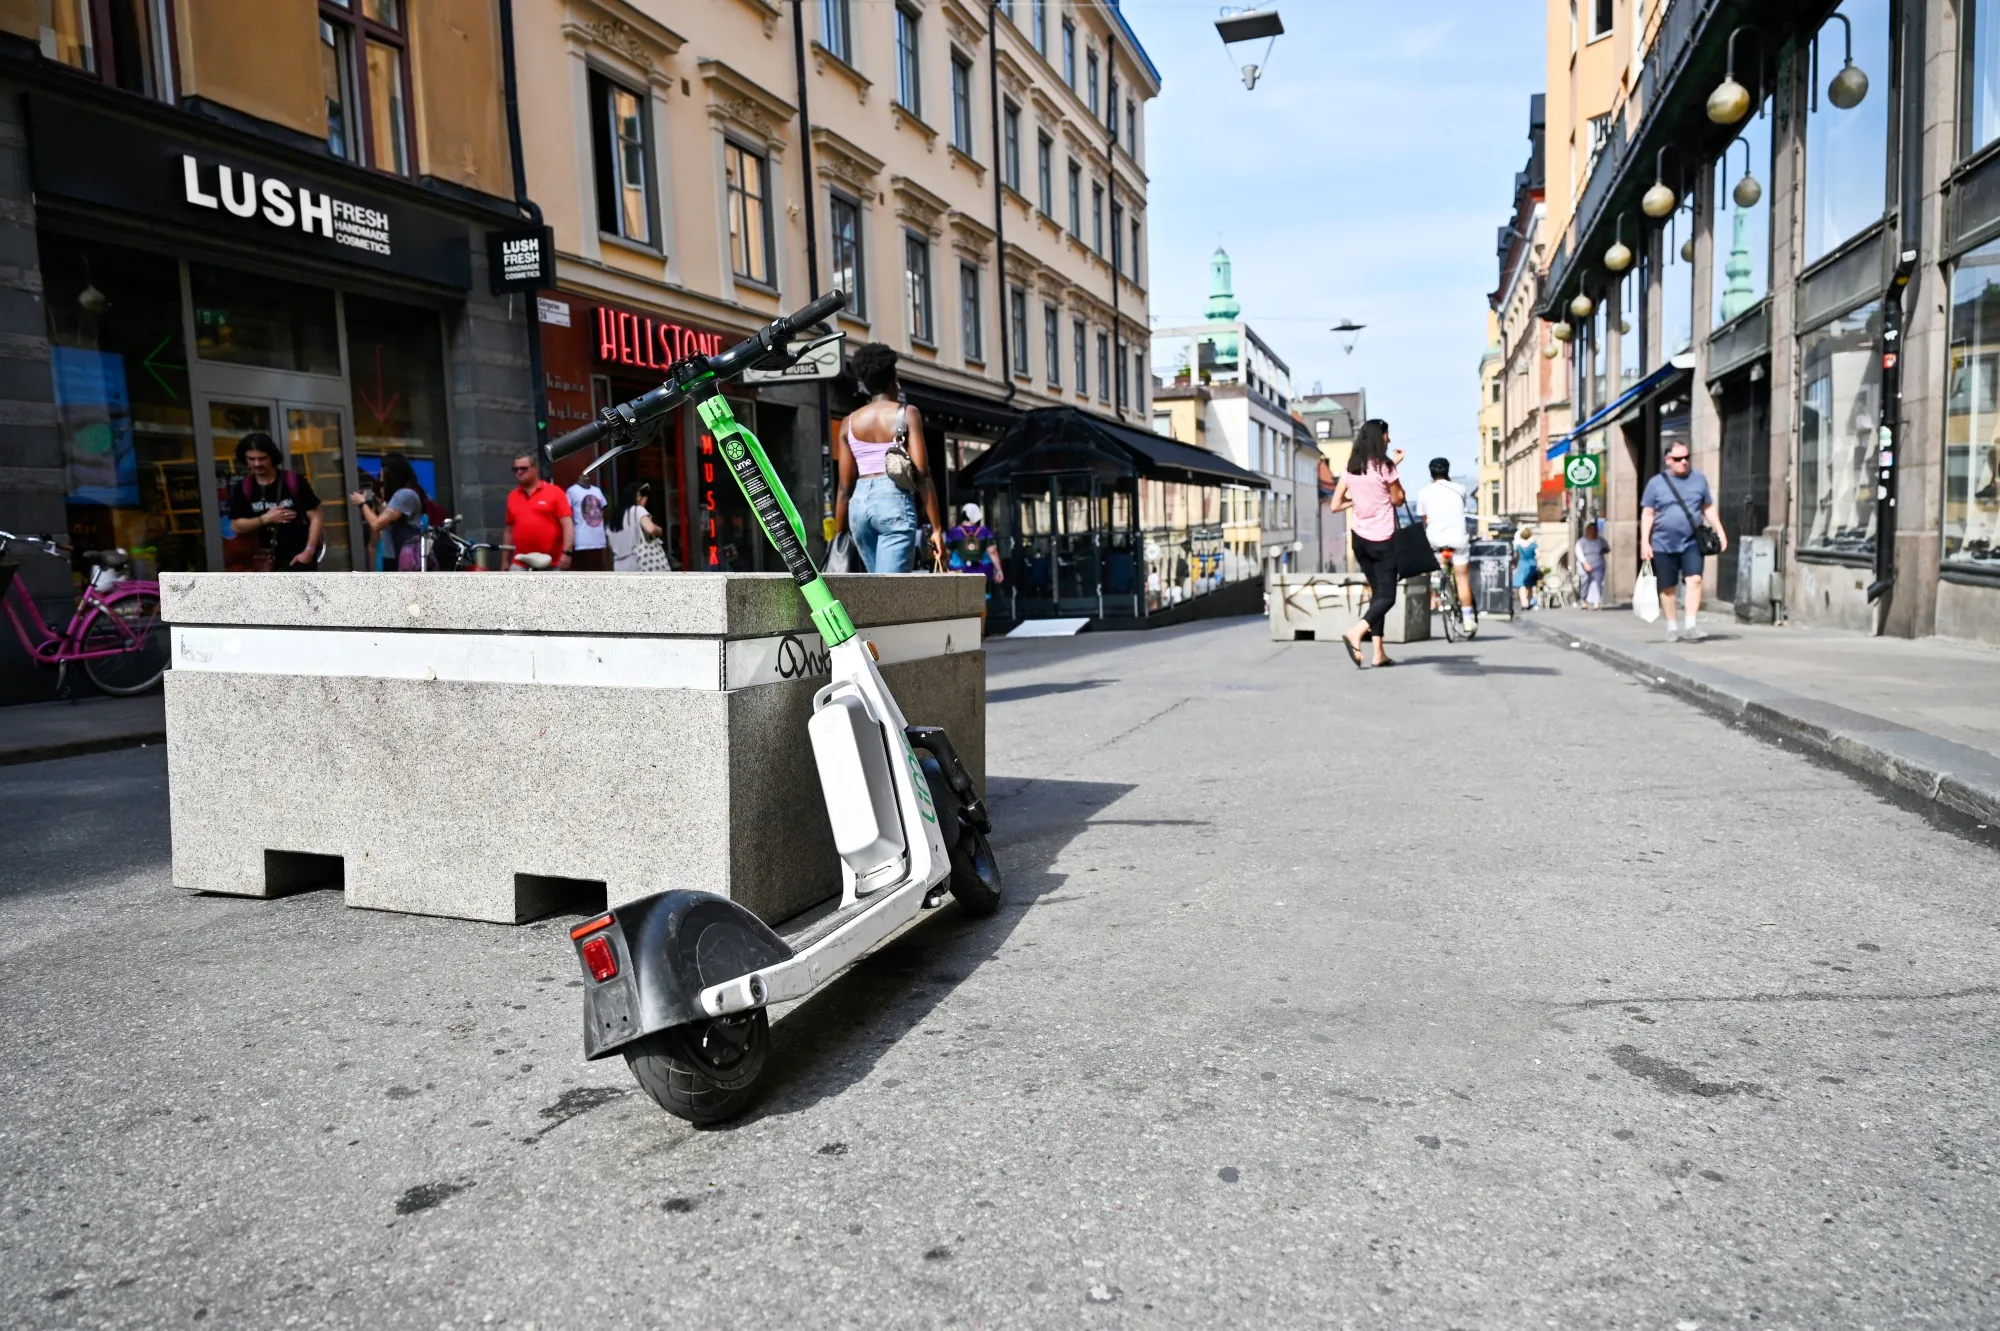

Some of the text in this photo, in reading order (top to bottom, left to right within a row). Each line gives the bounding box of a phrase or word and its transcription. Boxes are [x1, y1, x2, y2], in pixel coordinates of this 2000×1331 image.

[183, 154, 333, 238] LUSH
[333, 200, 389, 231] FRESH
[334, 220, 390, 243] HANDMADE
[335, 233, 391, 255] COSMETICS
[503, 238, 539, 254] LUSH
[503, 252, 540, 265] FRESH
[504, 263, 540, 272] HANDMADE
[505, 270, 541, 280] COSMETICS
[702, 434, 719, 566] MUSIK
